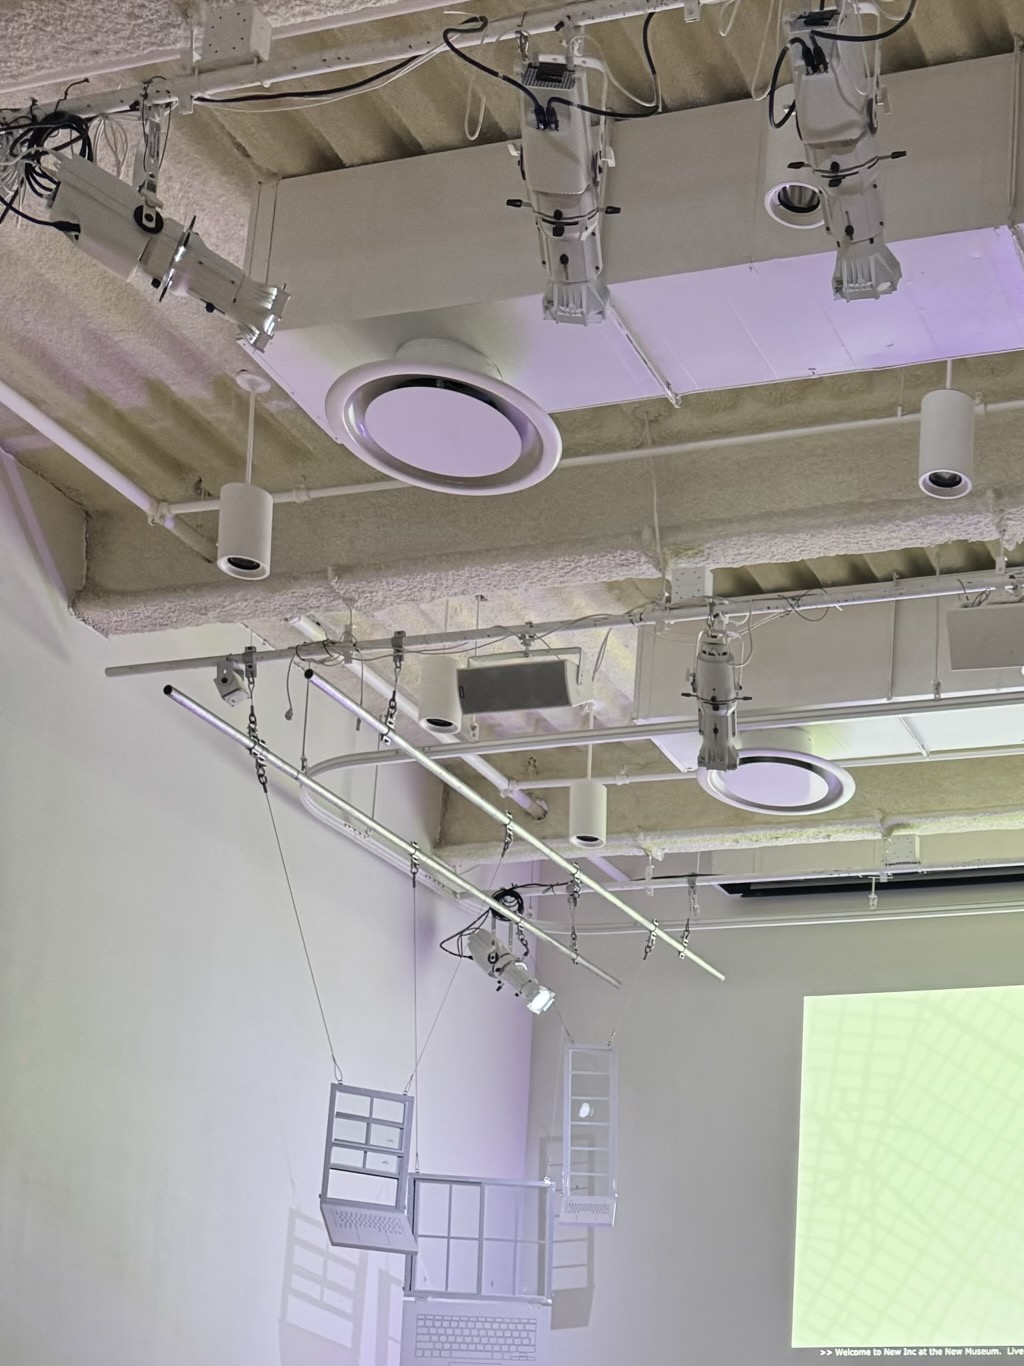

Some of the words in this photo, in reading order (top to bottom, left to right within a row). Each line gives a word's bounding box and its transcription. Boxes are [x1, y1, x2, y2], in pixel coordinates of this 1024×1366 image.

[835, 1348, 872, 1356] Welcome
[873, 1348, 883, 1356] to
[884, 1348, 902, 1356] New
[903, 1348, 917, 1356] Inc
[929, 1347, 943, 1355] the
[945, 1347, 963, 1355] New
[965, 1347, 1002, 1355] Museum.
[1007, 1346, 1024, 1355] Live
